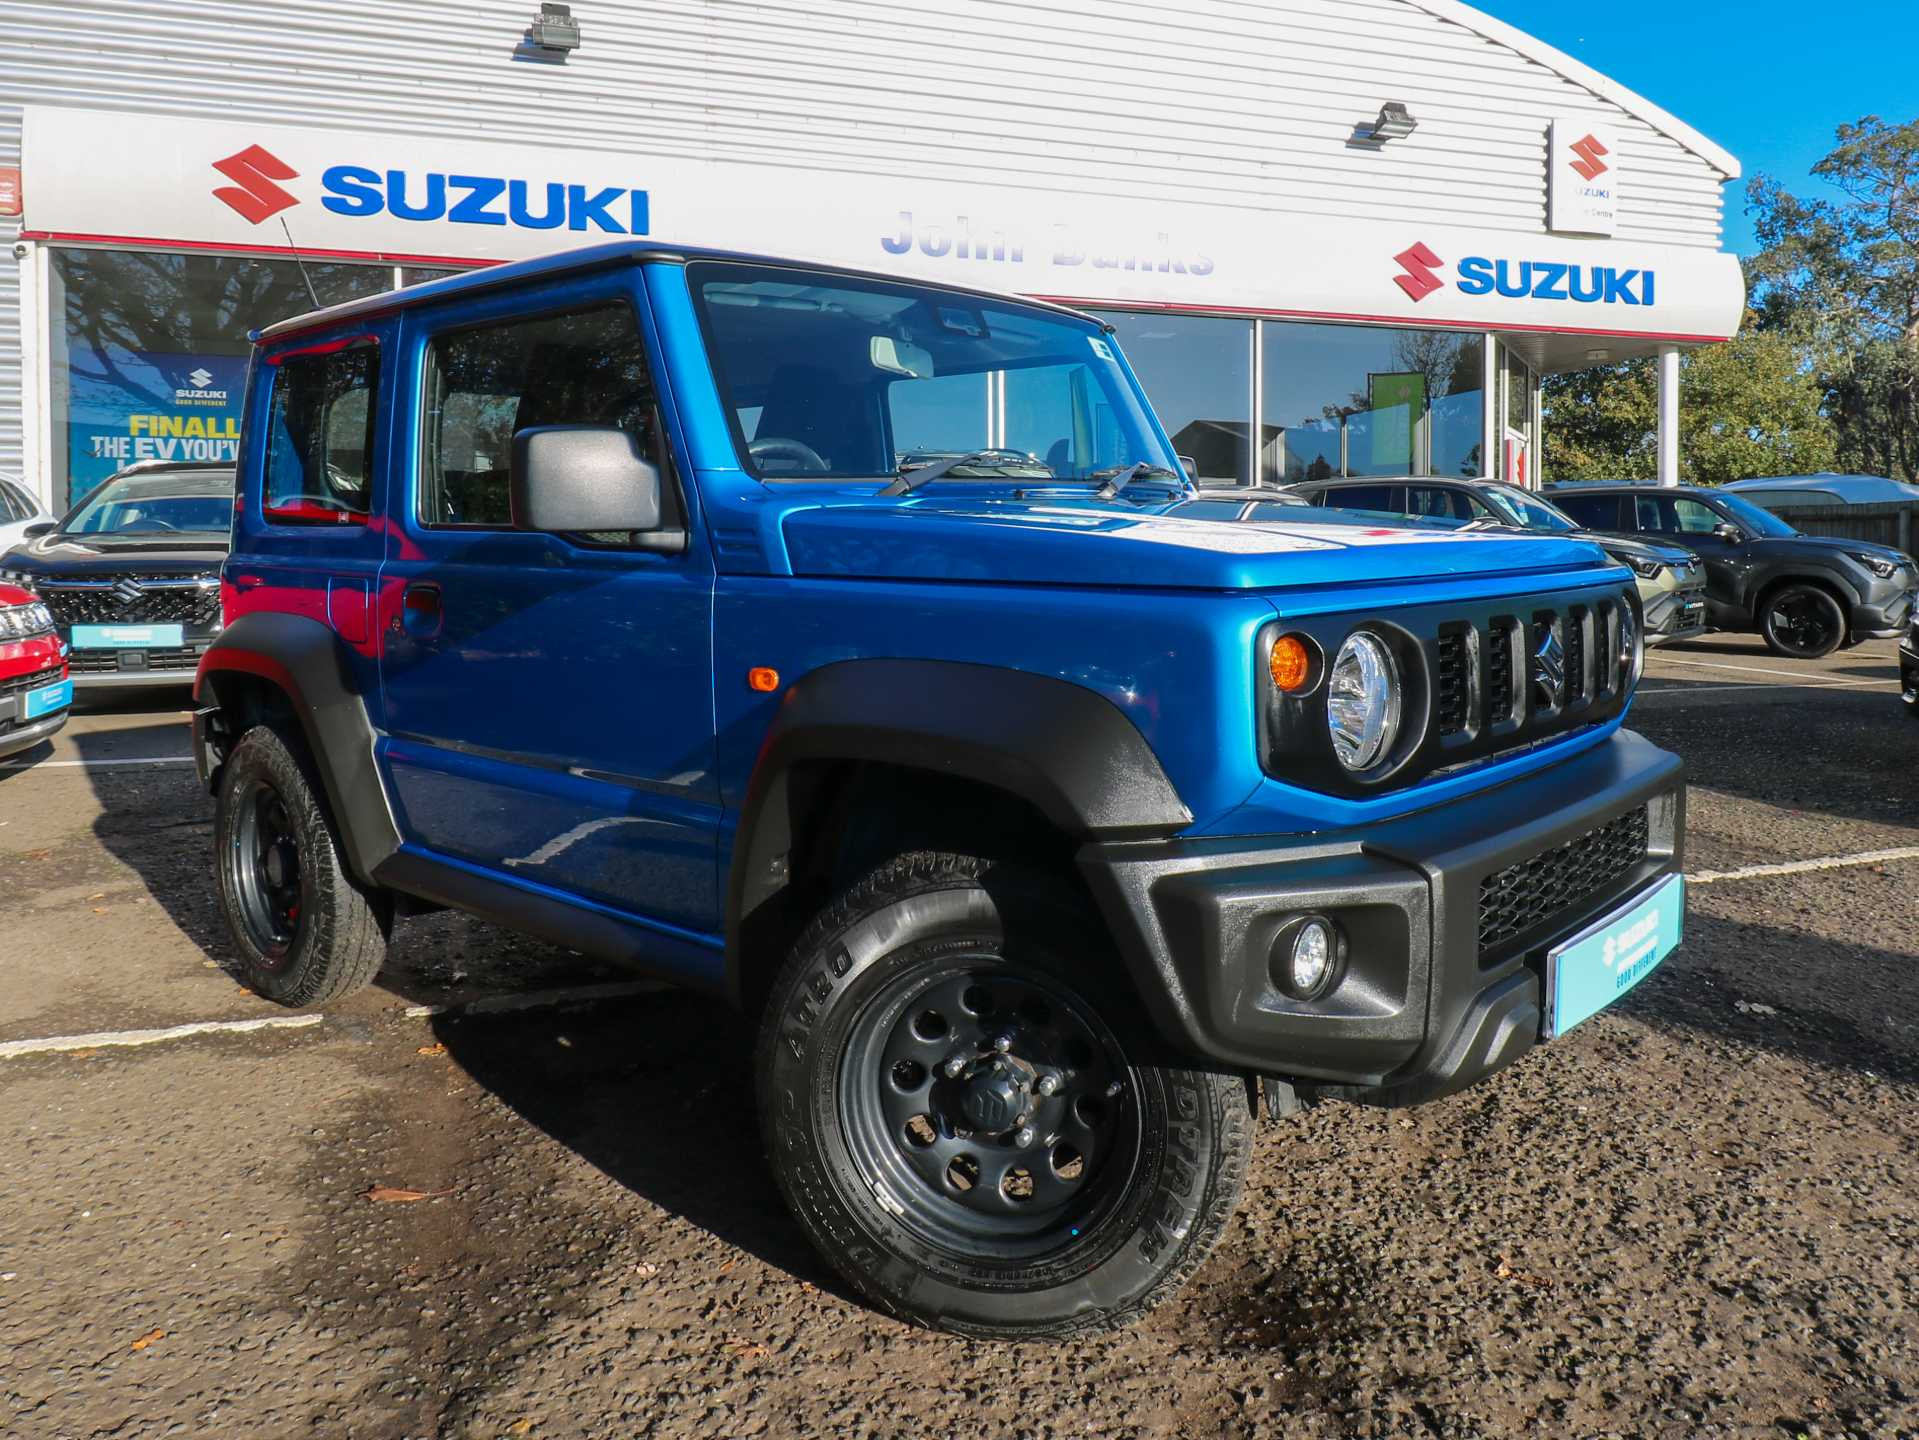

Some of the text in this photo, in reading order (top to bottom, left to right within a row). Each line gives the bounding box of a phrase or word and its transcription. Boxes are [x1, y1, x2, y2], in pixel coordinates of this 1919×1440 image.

[320, 165, 650, 236] SUZUKI
[880, 211, 1024, 263] John
[1457, 255, 1655, 307] SUZUKI
[176, 389, 226, 399] SUZUKI
[90, 436, 131, 458] THE
[135, 437, 176, 459] EV
